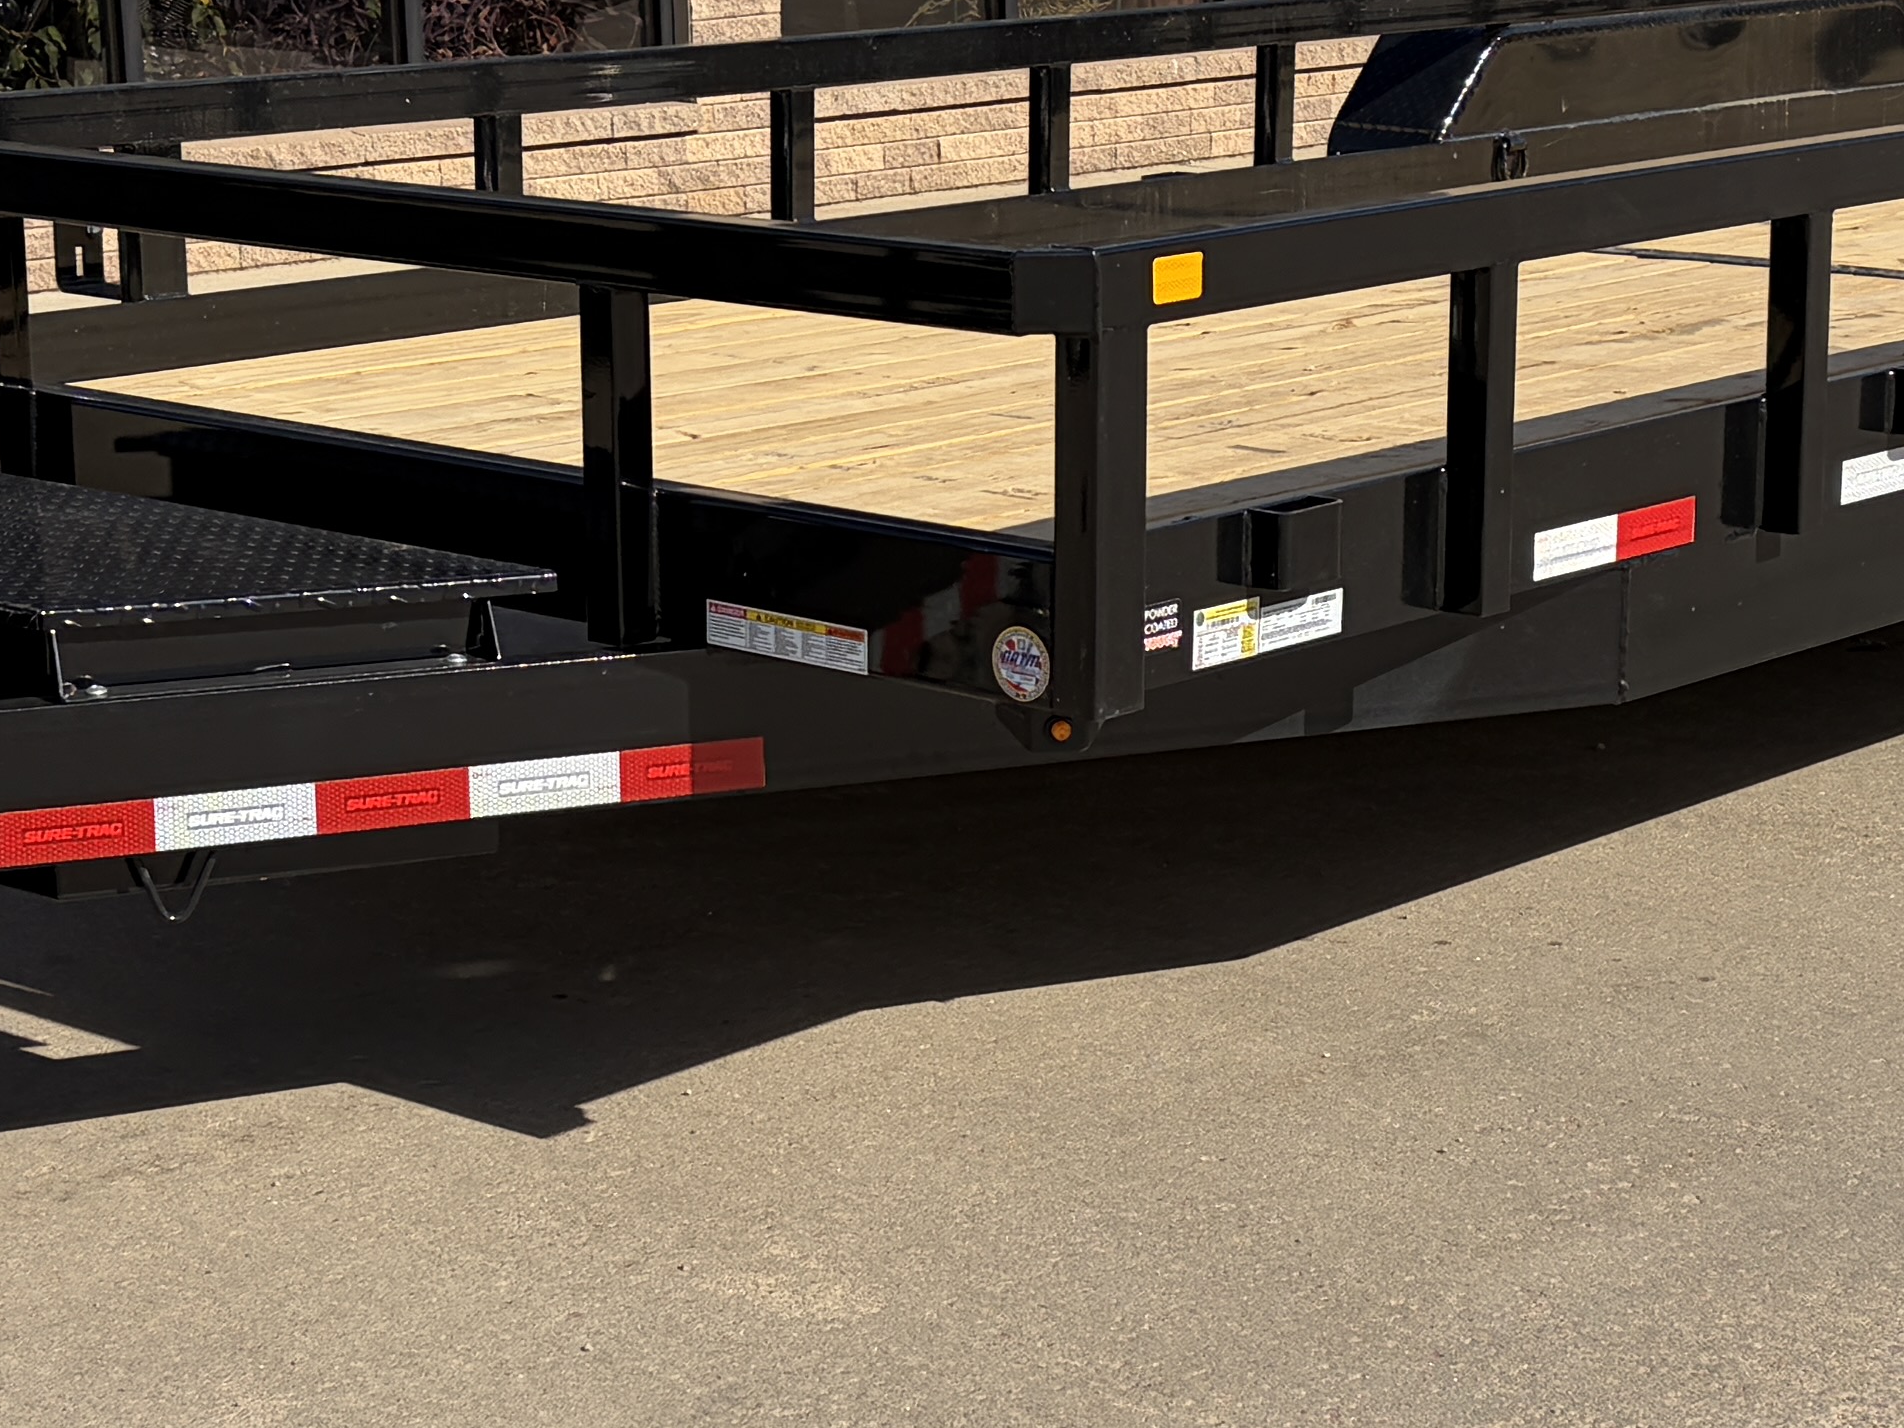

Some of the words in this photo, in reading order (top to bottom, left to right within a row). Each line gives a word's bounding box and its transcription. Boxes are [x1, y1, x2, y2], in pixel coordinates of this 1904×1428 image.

[498, 773, 590, 795] SURE-TRAC
[346, 790, 439, 811] SURE-TRAC
[188, 806, 285, 828] SURE-TRAC
[23, 822, 123, 844] SURE-TRAC
